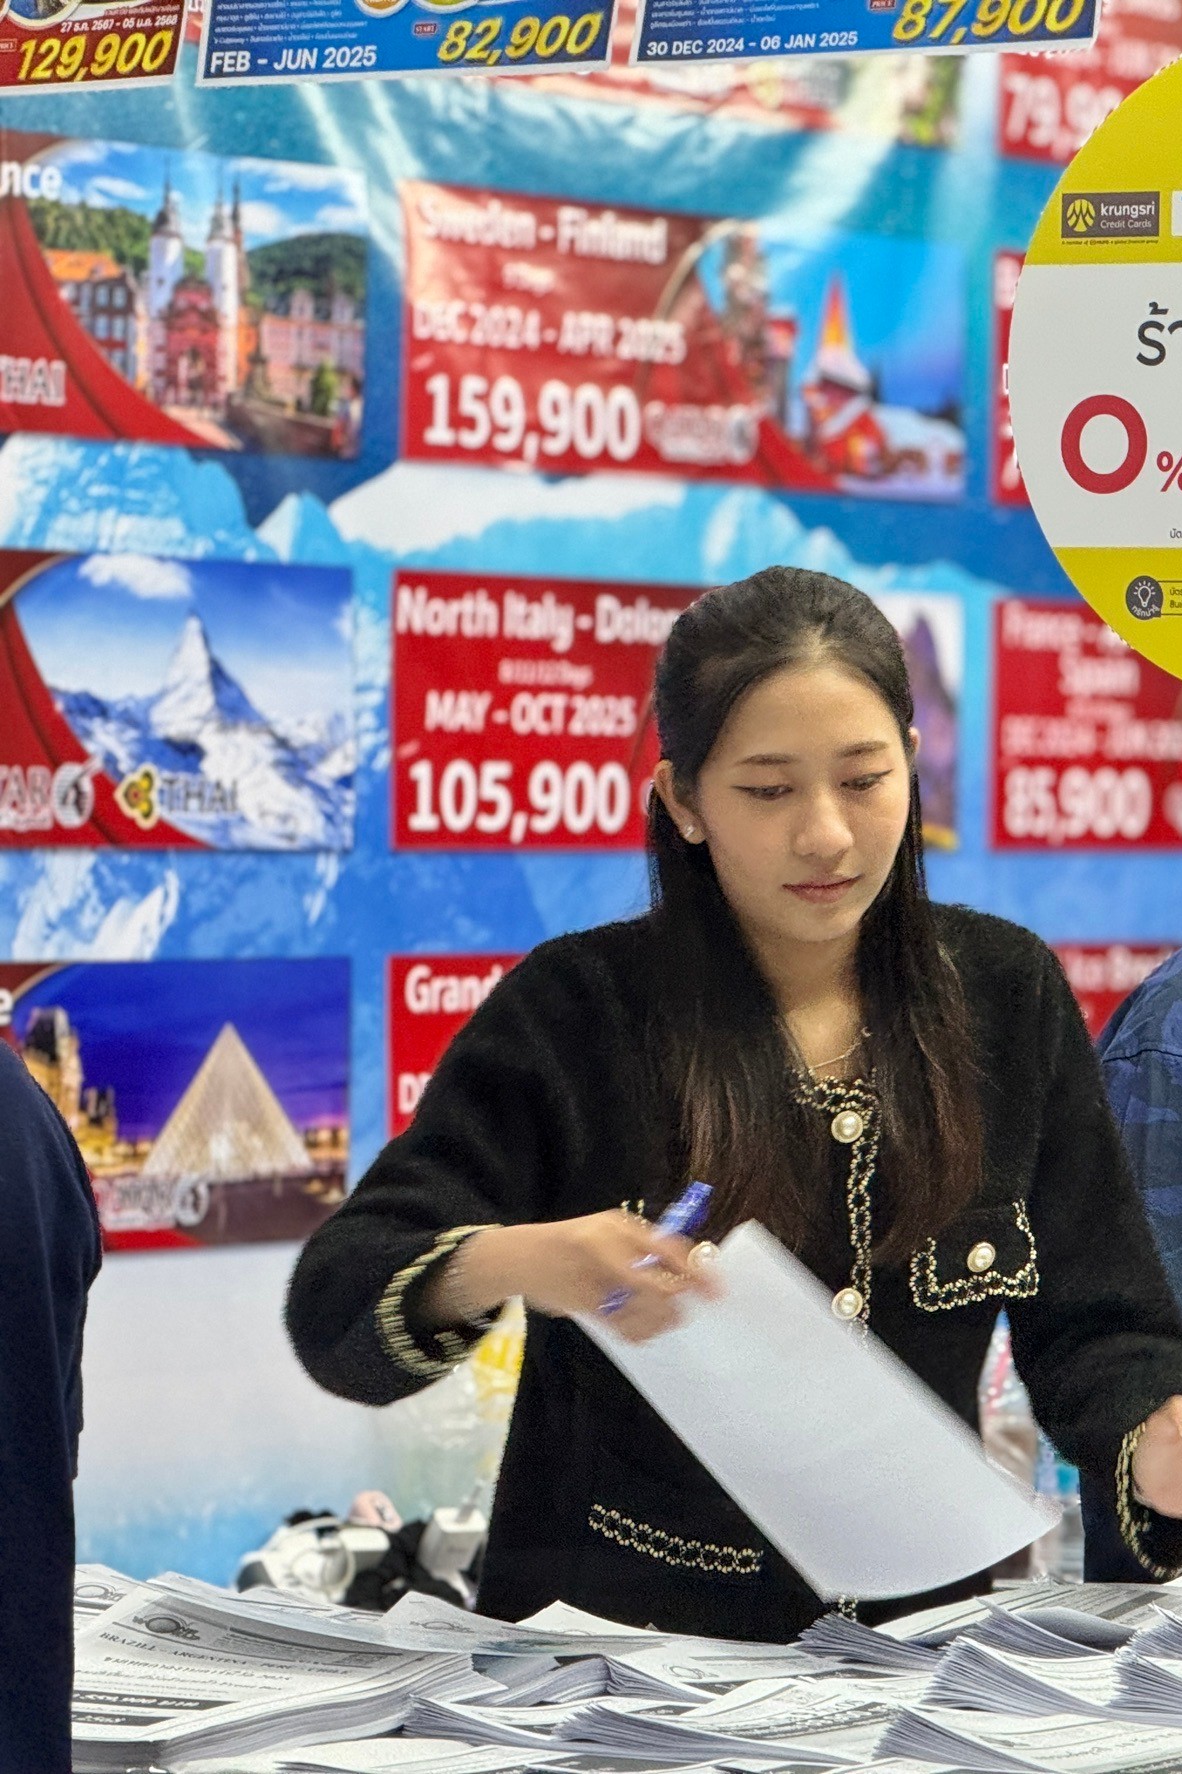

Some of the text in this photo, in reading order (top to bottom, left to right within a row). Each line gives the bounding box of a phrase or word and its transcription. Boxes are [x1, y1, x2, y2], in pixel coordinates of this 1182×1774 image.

[60, 22, 72, 33] 27
[437, 12, 603, 66] 82,900
[646, 42, 668, 56] 30
[671, 40, 702, 56] DEC
[706, 38, 744, 54] 2024
[760, 36, 780, 50] 06
[784, 33, 816, 49] JAN
[819, 31, 858, 47] 2025
[893, 0, 1083, 44] 87,900
[18, 29, 174, 81] 129,900
[210, 51, 251, 73] FEB
[273, 47, 318, 71] JUN
[322, 45, 377, 69] 2025
[1100, 219, 1152, 229] Credit Cards
[1101, 201, 1155, 219] krungsri
[0, 356, 66, 406] HAI
[424, 373, 642, 463] 159,900
[397, 586, 499, 638] North
[503, 590, 575, 653] Italy
[425, 690, 492, 733] MAY
[510, 692, 568, 735] OCT
[569, 695, 636, 738] 2025
[407, 759, 631, 844] 105,900
[1003, 764, 1152, 846] 85,900
